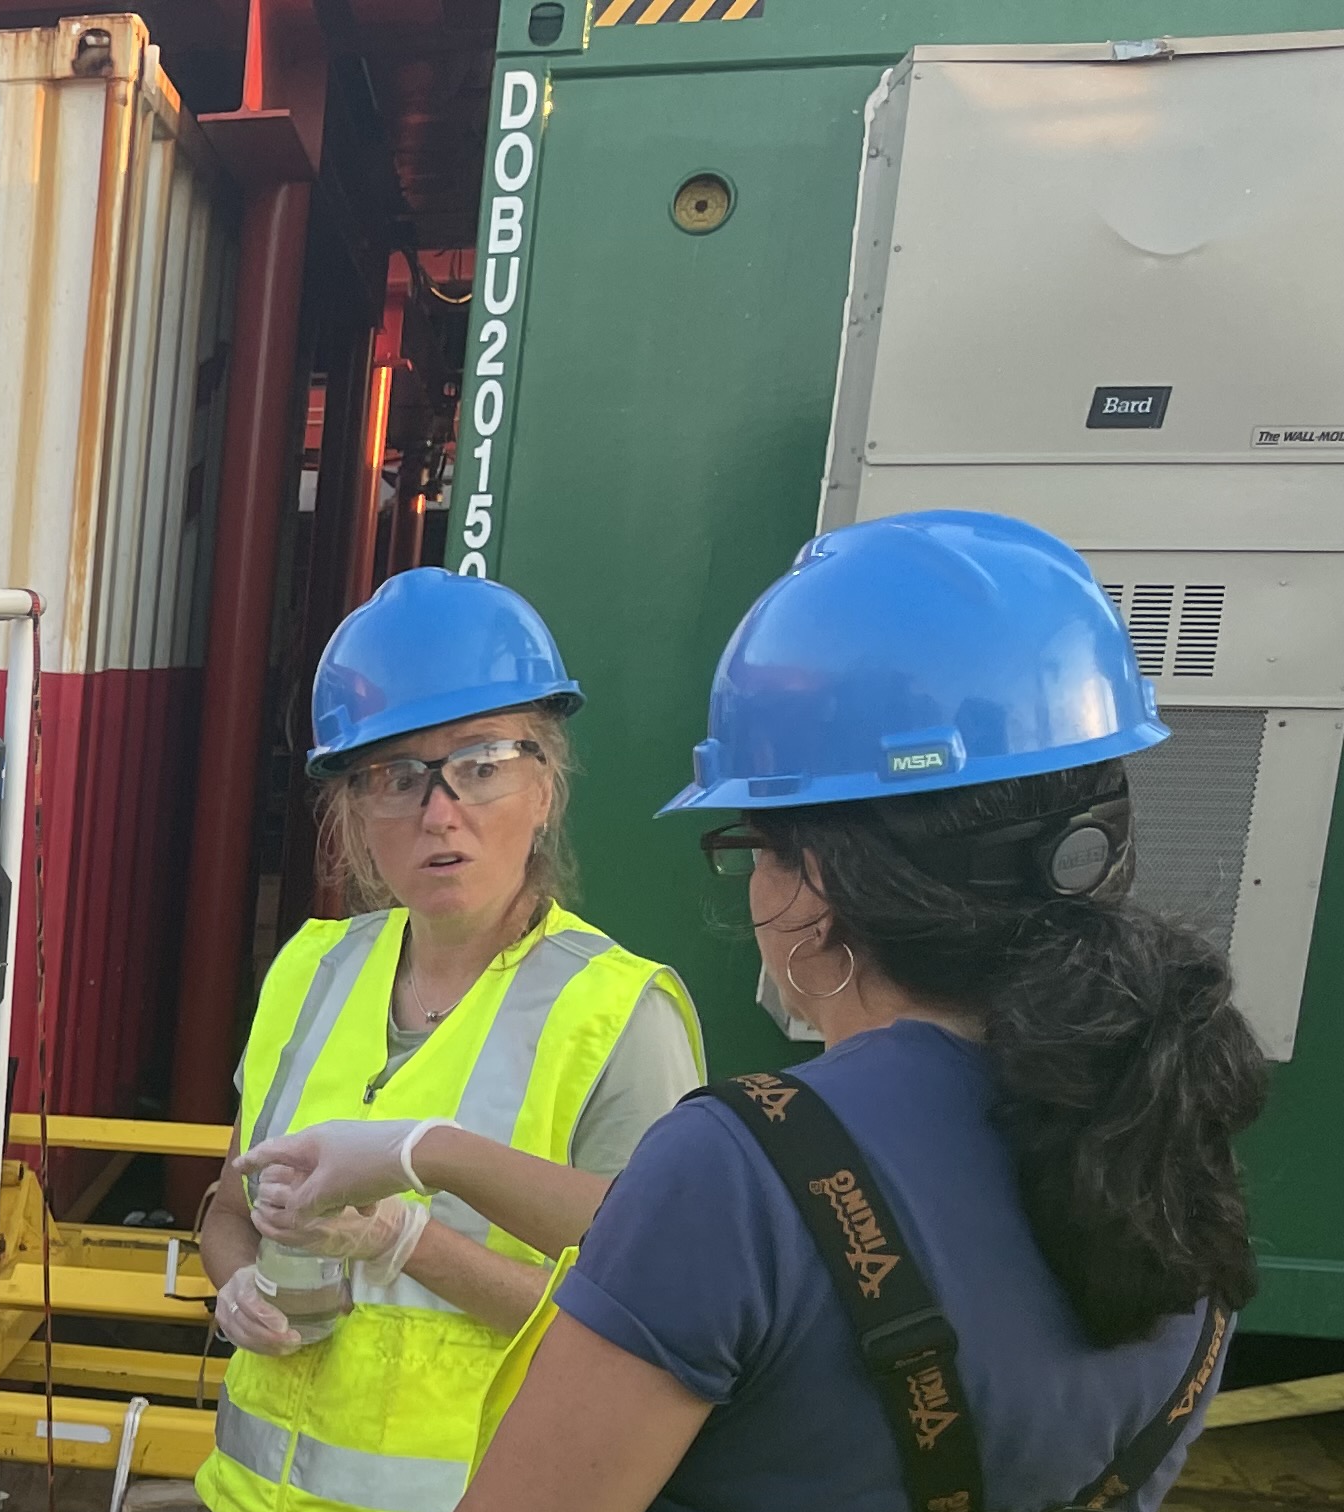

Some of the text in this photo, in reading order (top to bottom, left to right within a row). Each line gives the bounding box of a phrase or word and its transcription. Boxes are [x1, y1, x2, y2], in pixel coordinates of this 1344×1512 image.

[1102, 396, 1153, 414] Bard
[1258, 431, 1280, 442] The
[893, 752, 943, 771] MSA
[827, 1168, 902, 1299] VIKING
